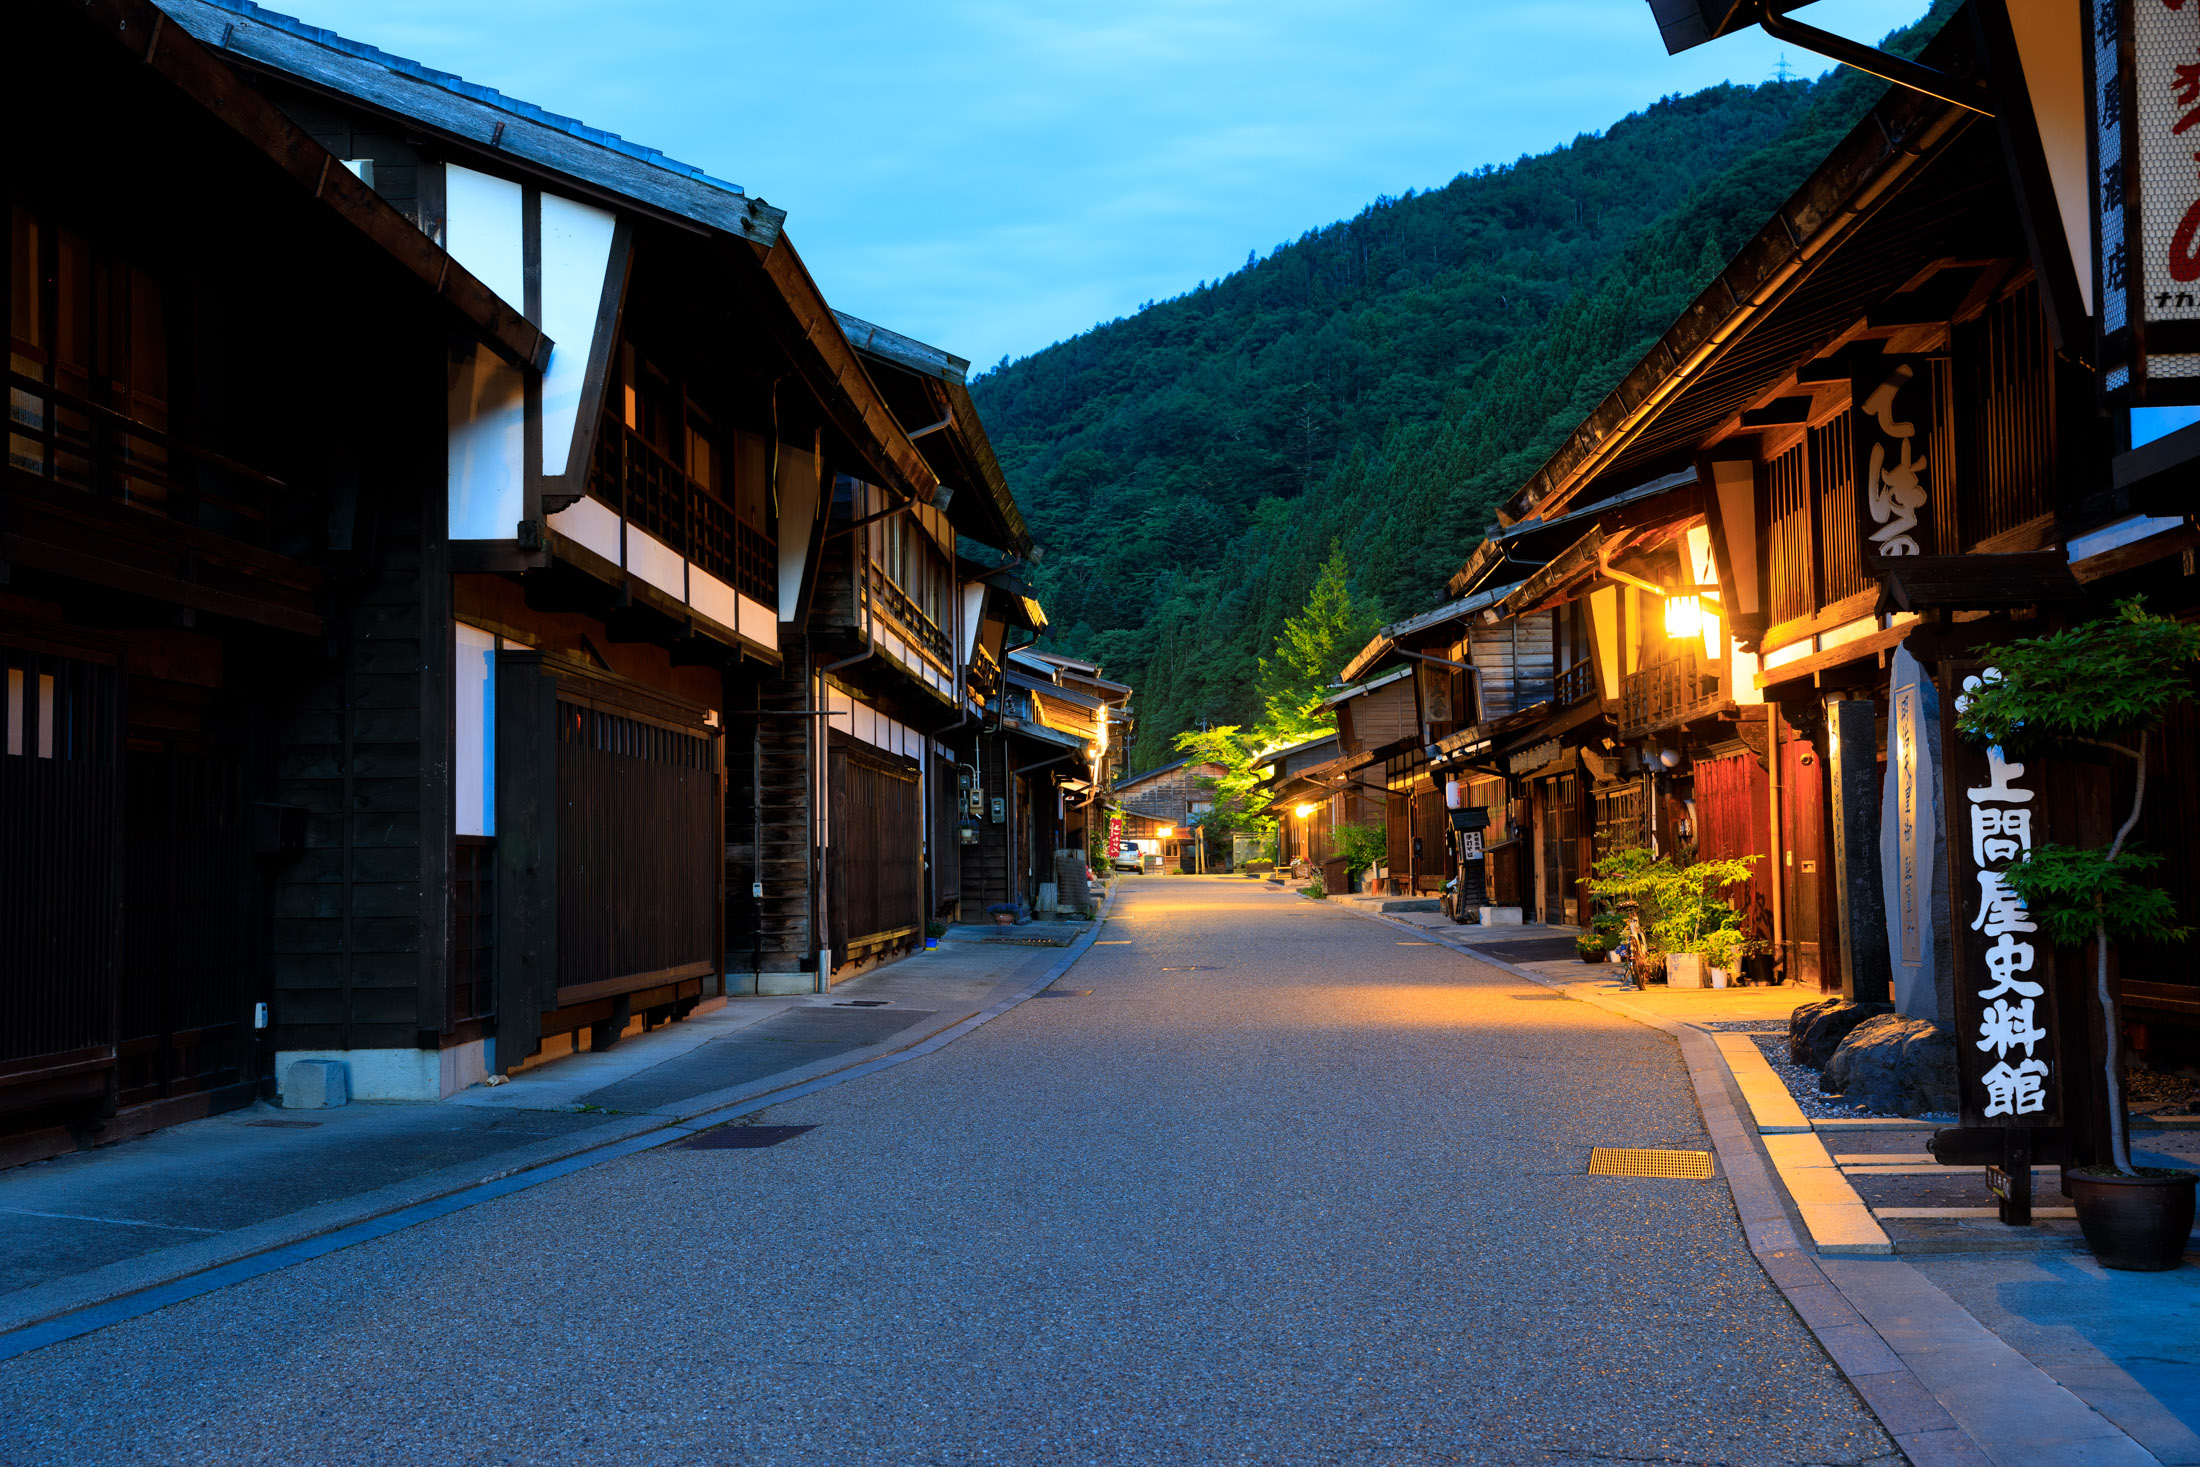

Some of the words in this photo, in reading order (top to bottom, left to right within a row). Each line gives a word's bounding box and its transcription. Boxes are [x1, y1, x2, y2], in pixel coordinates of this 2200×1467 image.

[1967, 743, 2049, 1118] 上問屋史料館
